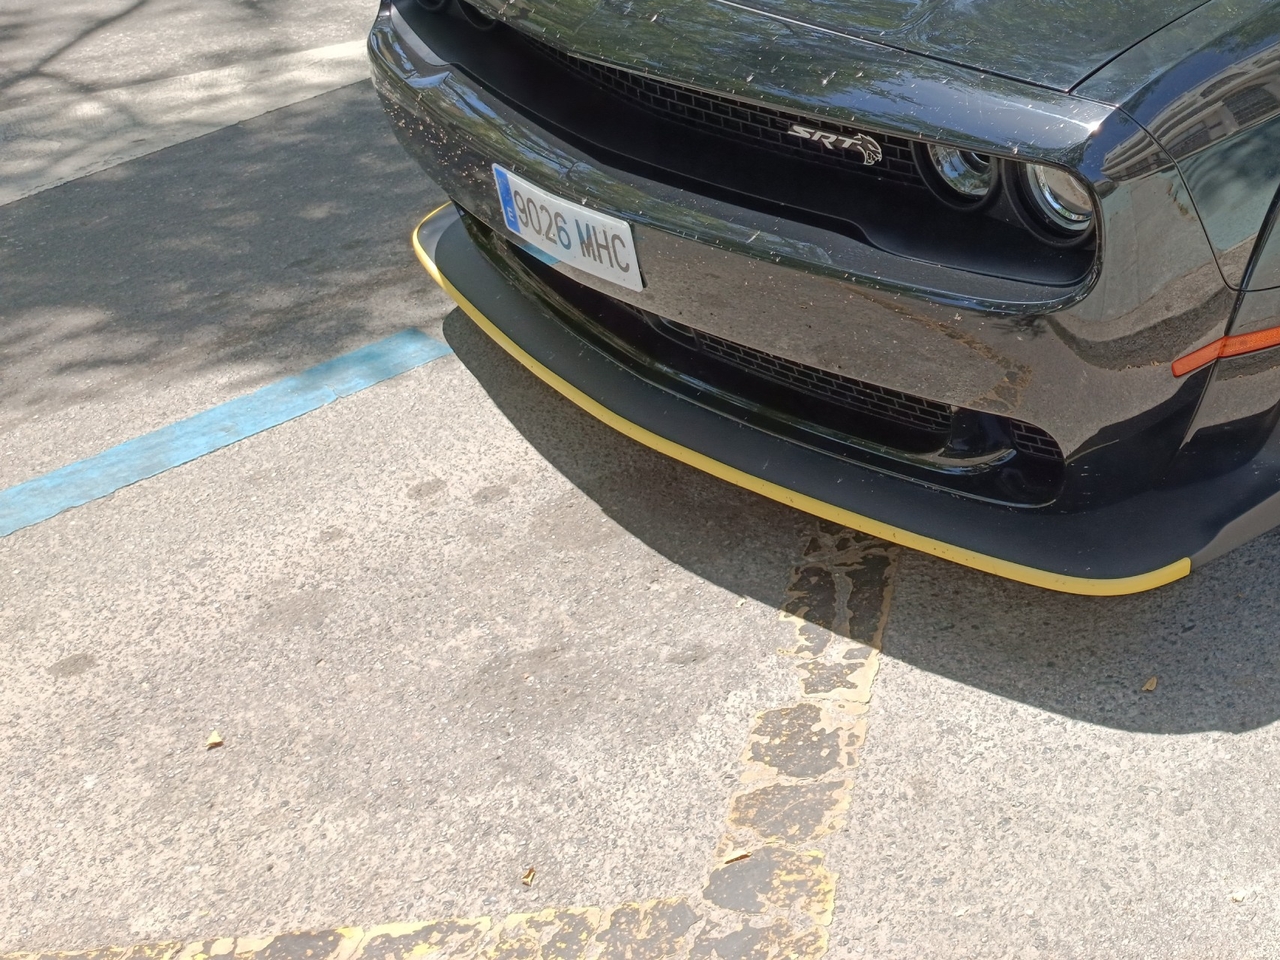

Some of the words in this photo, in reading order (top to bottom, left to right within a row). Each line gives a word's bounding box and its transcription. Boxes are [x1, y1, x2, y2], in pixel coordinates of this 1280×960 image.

[787, 124, 862, 150] SRT
[507, 206, 515, 222] E
[513, 190, 573, 251] 9026
[574, 218, 630, 274] MHC
